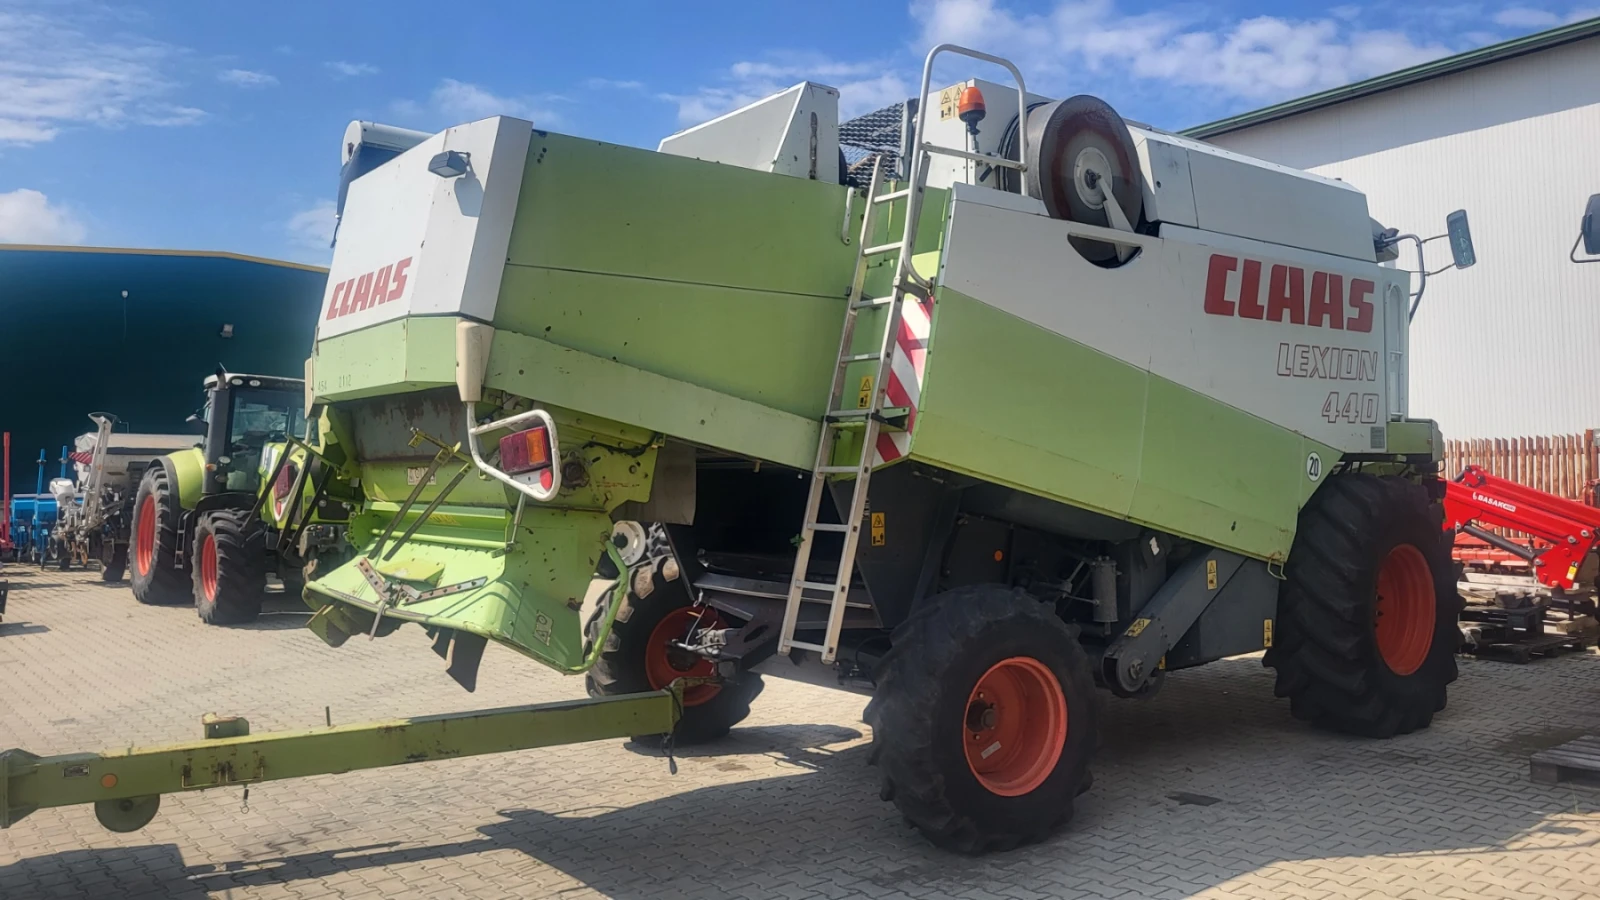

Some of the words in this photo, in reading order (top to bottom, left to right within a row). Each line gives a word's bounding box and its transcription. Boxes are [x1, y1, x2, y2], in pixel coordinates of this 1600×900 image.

[326, 256, 413, 321] CLAAS
[1204, 253, 1375, 333] CLAAS
[1276, 342, 1378, 381] LEXION
[1321, 391, 1380, 424] 440
[1308, 456, 1319, 477] 20
[1477, 494, 1504, 509] BASAK
